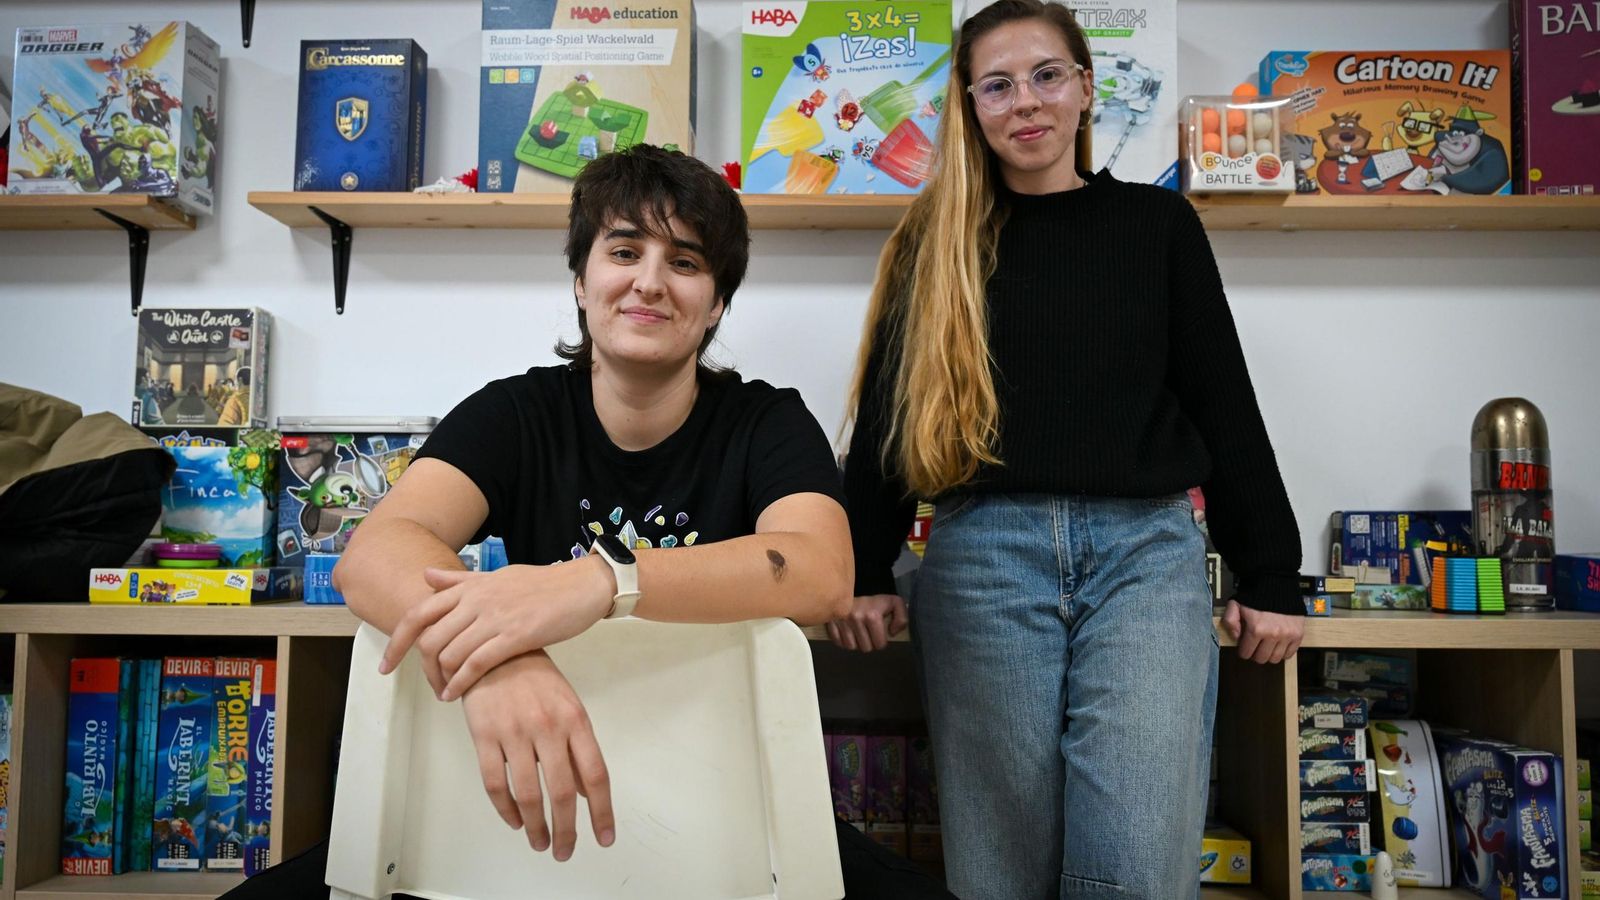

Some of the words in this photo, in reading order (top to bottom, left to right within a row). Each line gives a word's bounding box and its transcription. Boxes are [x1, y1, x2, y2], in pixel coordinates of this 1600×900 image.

[570, 6, 611, 24] HABA
[613, 7, 679, 20] education
[751, 9, 798, 27] HABA
[49, 30, 77, 42] MARVEL
[490, 34, 584, 46] Raum-Lage-Spiel
[586, 34, 655, 45] Wackelwald
[20, 42, 104, 54] DAGGER
[839, 26, 917, 64] ¡Zas!
[308, 49, 405, 66] Carcassonne
[489, 52, 523, 62] Wobble
[524, 51, 549, 62] Wood
[551, 51, 581, 62] Spatial
[584, 51, 636, 63] Positioning
[637, 52, 665, 62] Game
[1335, 54, 1453, 85] Cartoon
[1459, 61, 1500, 91] It!
[1343, 84, 1382, 97] Hilarious
[1384, 83, 1420, 94] Memory
[1422, 84, 1459, 98] Drawing
[1461, 90, 1486, 104] Game
[1205, 174, 1253, 185] BATTLE
[152, 312, 164, 321] The
[164, 310, 199, 326] White
[200, 310, 242, 327] Castle
[168, 467, 237, 511] Finca
[94, 574, 122, 585] HABA
[166, 659, 201, 675] DEVIR
[215, 659, 250, 676] DEVIR
[225, 680, 252, 762] TORRE
[80, 719, 101, 818] LABIRINTO
[175, 716, 196, 806] LABERINT
[1520, 807, 1556, 869] FANTASMA
[74, 858, 110, 875] DEVIR
